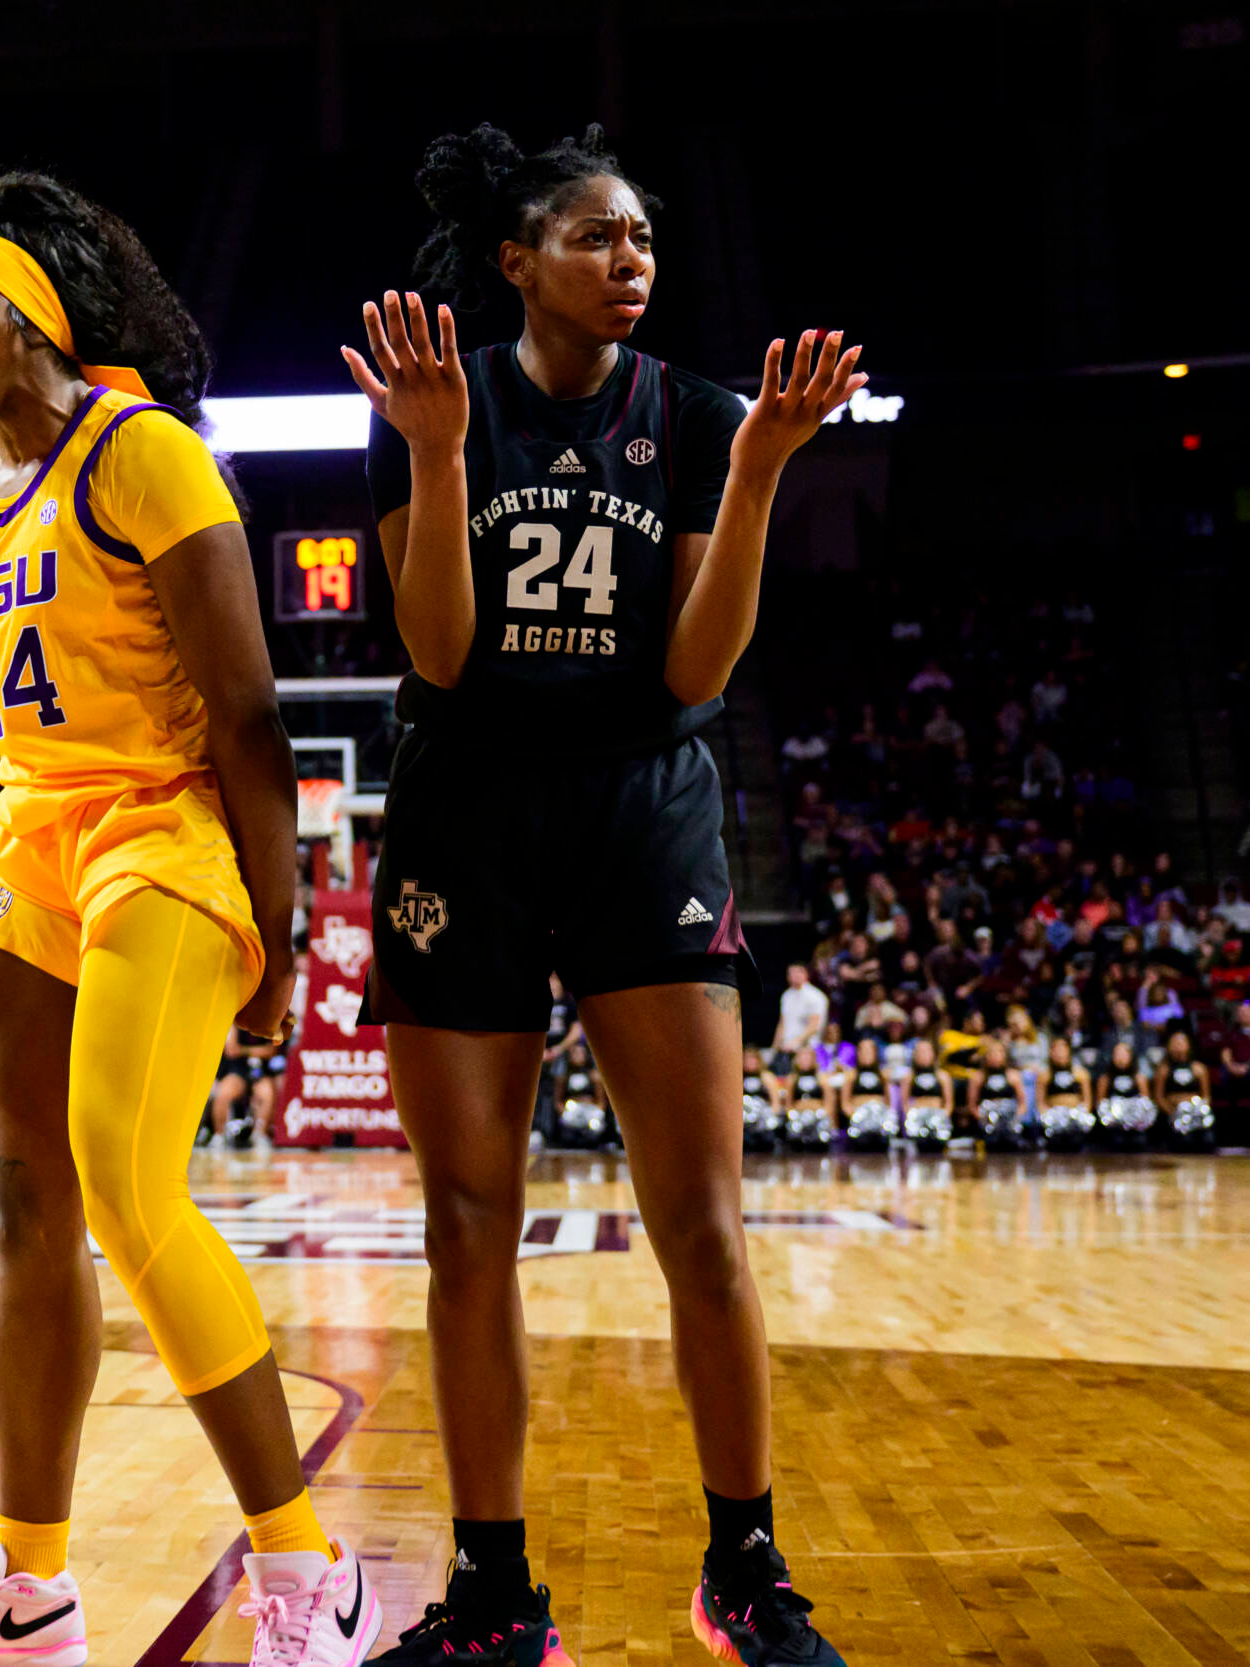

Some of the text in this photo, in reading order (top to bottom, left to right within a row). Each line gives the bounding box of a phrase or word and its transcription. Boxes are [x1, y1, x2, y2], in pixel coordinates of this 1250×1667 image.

[626, 439, 655, 464] SEC
[549, 463, 586, 474] adidas
[469, 487, 664, 544] FIGHTIN' TEXAS
[507, 522, 618, 616] 24
[501, 624, 616, 656] AGGIES
[678, 912, 714, 926] adidas
[300, 1050, 387, 1074] WELLS
